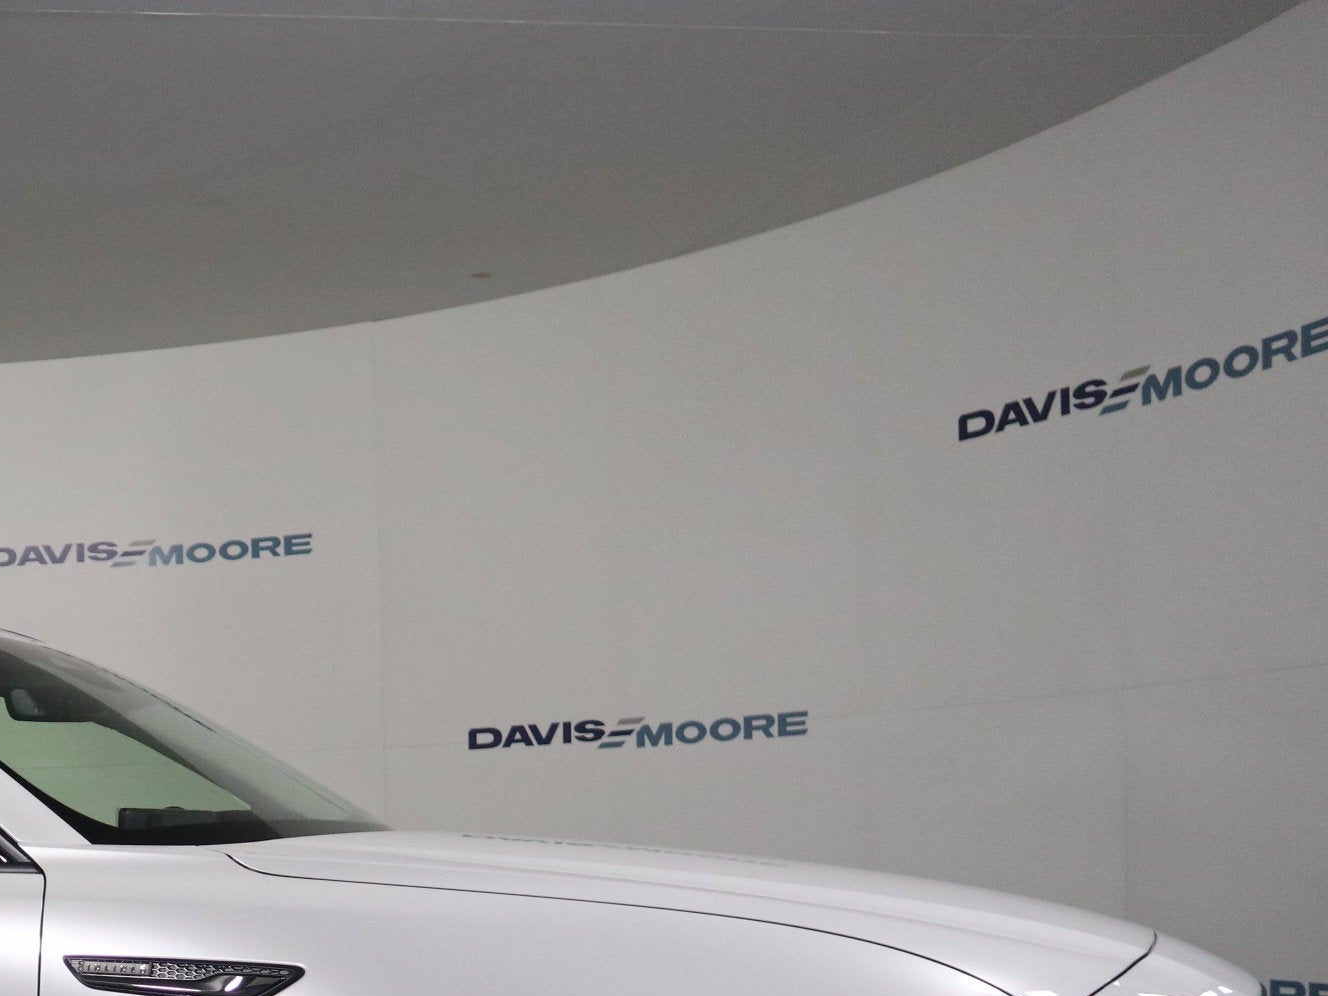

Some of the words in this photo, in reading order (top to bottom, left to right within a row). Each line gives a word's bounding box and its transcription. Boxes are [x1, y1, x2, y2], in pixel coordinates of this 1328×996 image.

[958, 378, 1109, 441] DAVIS
[1141, 316, 1328, 406] MOORE
[148, 533, 313, 566] MOORE
[468, 719, 606, 750] DAVIS
[636, 710, 808, 748] MOORE
